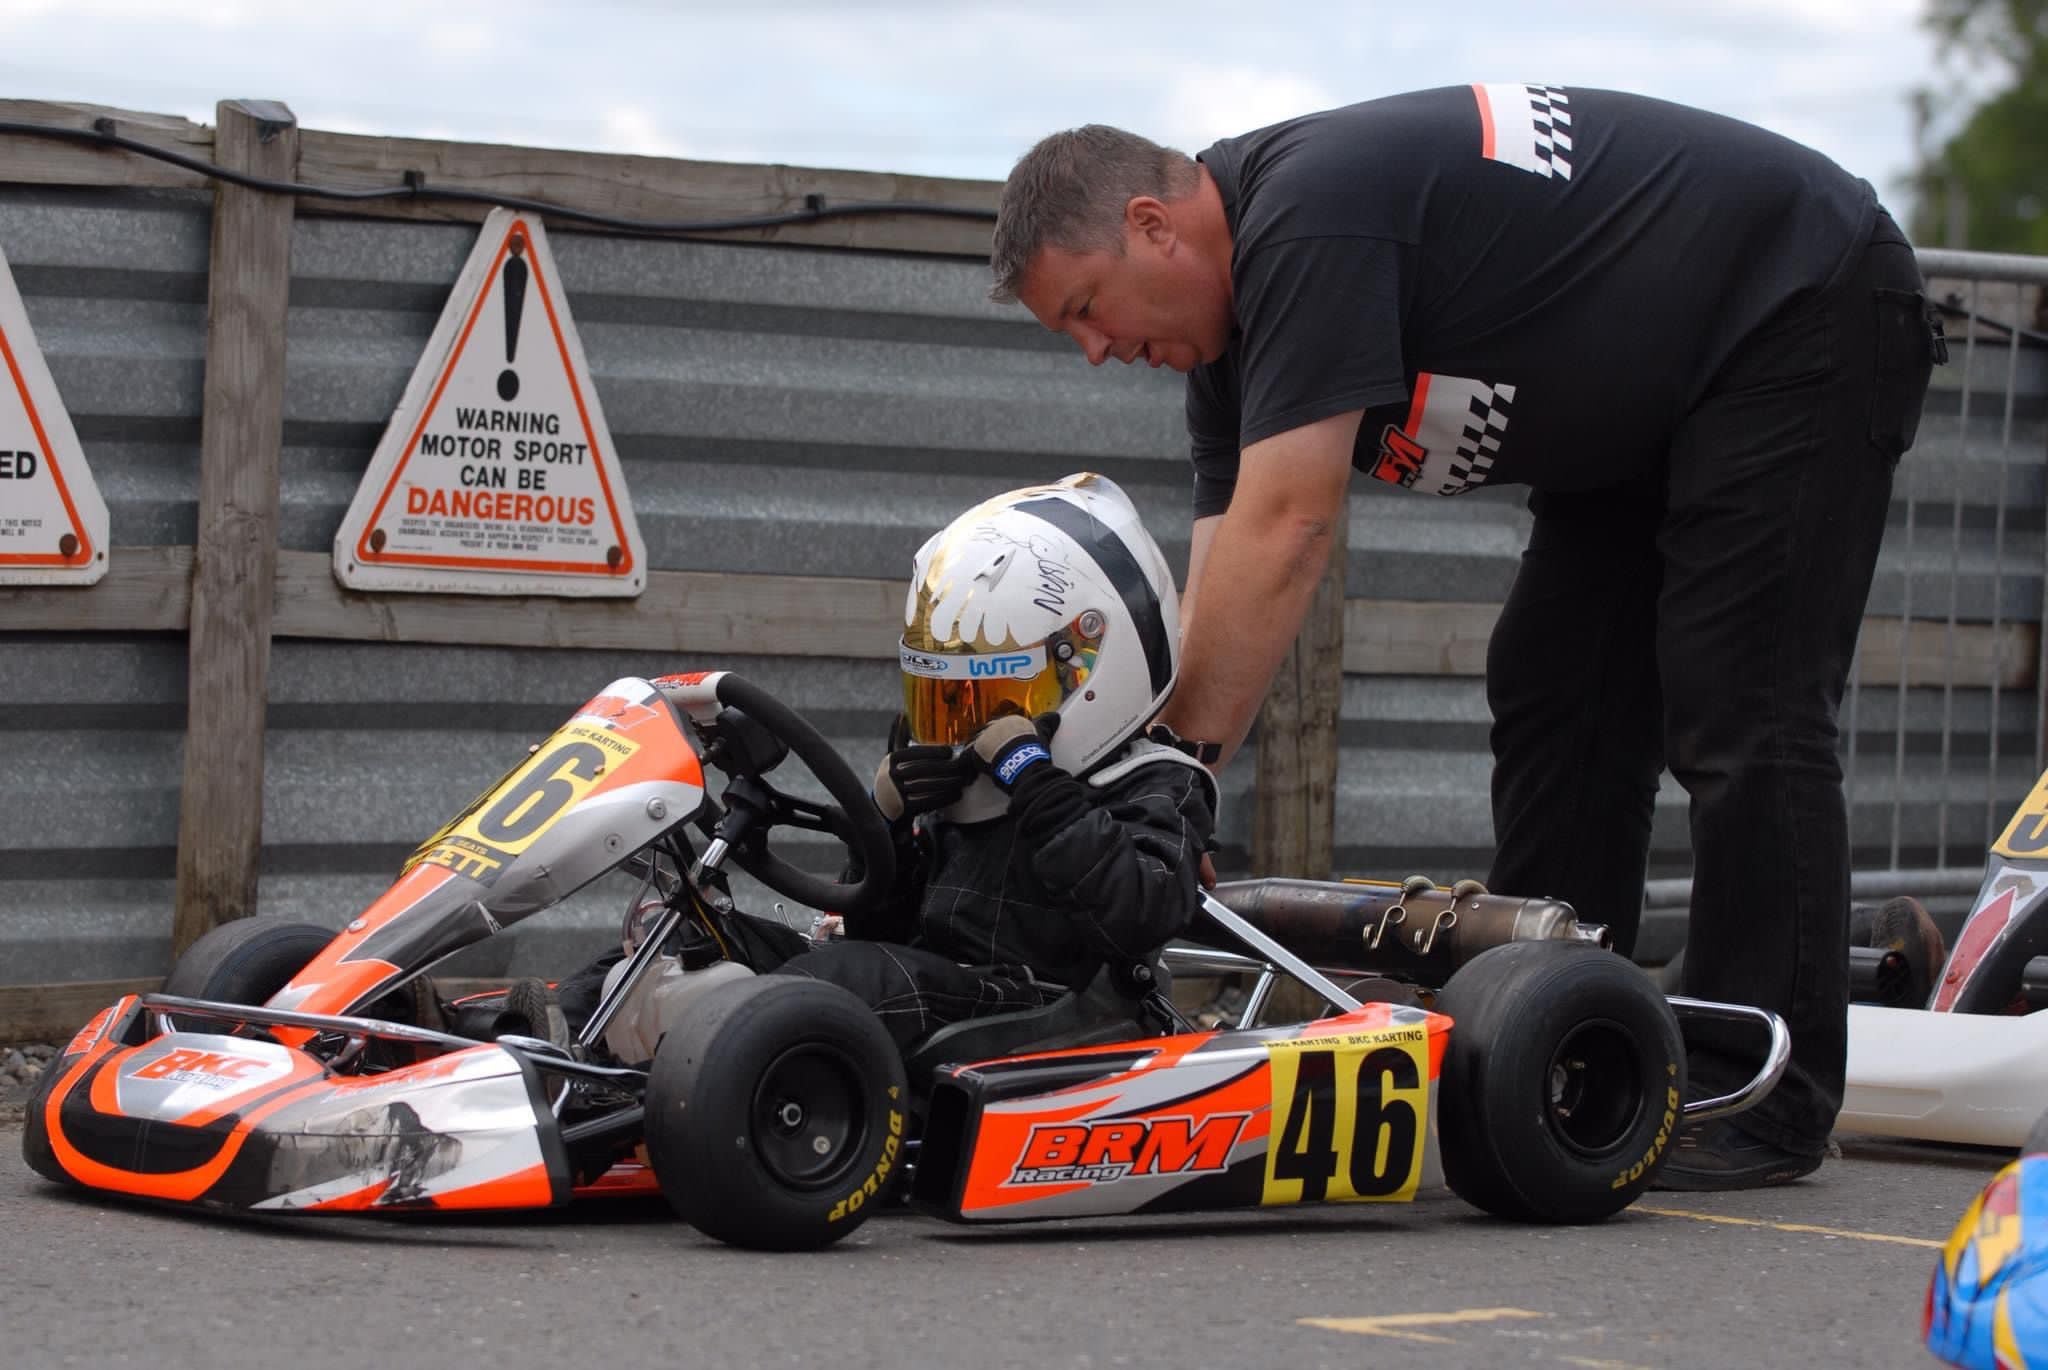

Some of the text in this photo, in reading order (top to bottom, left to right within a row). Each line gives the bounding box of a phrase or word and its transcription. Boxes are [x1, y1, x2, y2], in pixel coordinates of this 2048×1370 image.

[456, 407, 560, 435] WARNING
[421, 434, 588, 465] MOTOR SPORT
[460, 465, 547, 491] CAN BE
[407, 487, 595, 526] DANGEROUS
[969, 655, 1032, 677] WTP
[589, 732, 632, 756] KARTING
[1374, 1030, 1424, 1043] KARTING
[1273, 1046, 1420, 1201] 46
[1017, 1113, 1251, 1176] BRM
[1610, 1086, 1680, 1191] DUNLOP
[827, 1109, 903, 1223] DUNLOP
[1011, 1165, 1126, 1184] Racing
